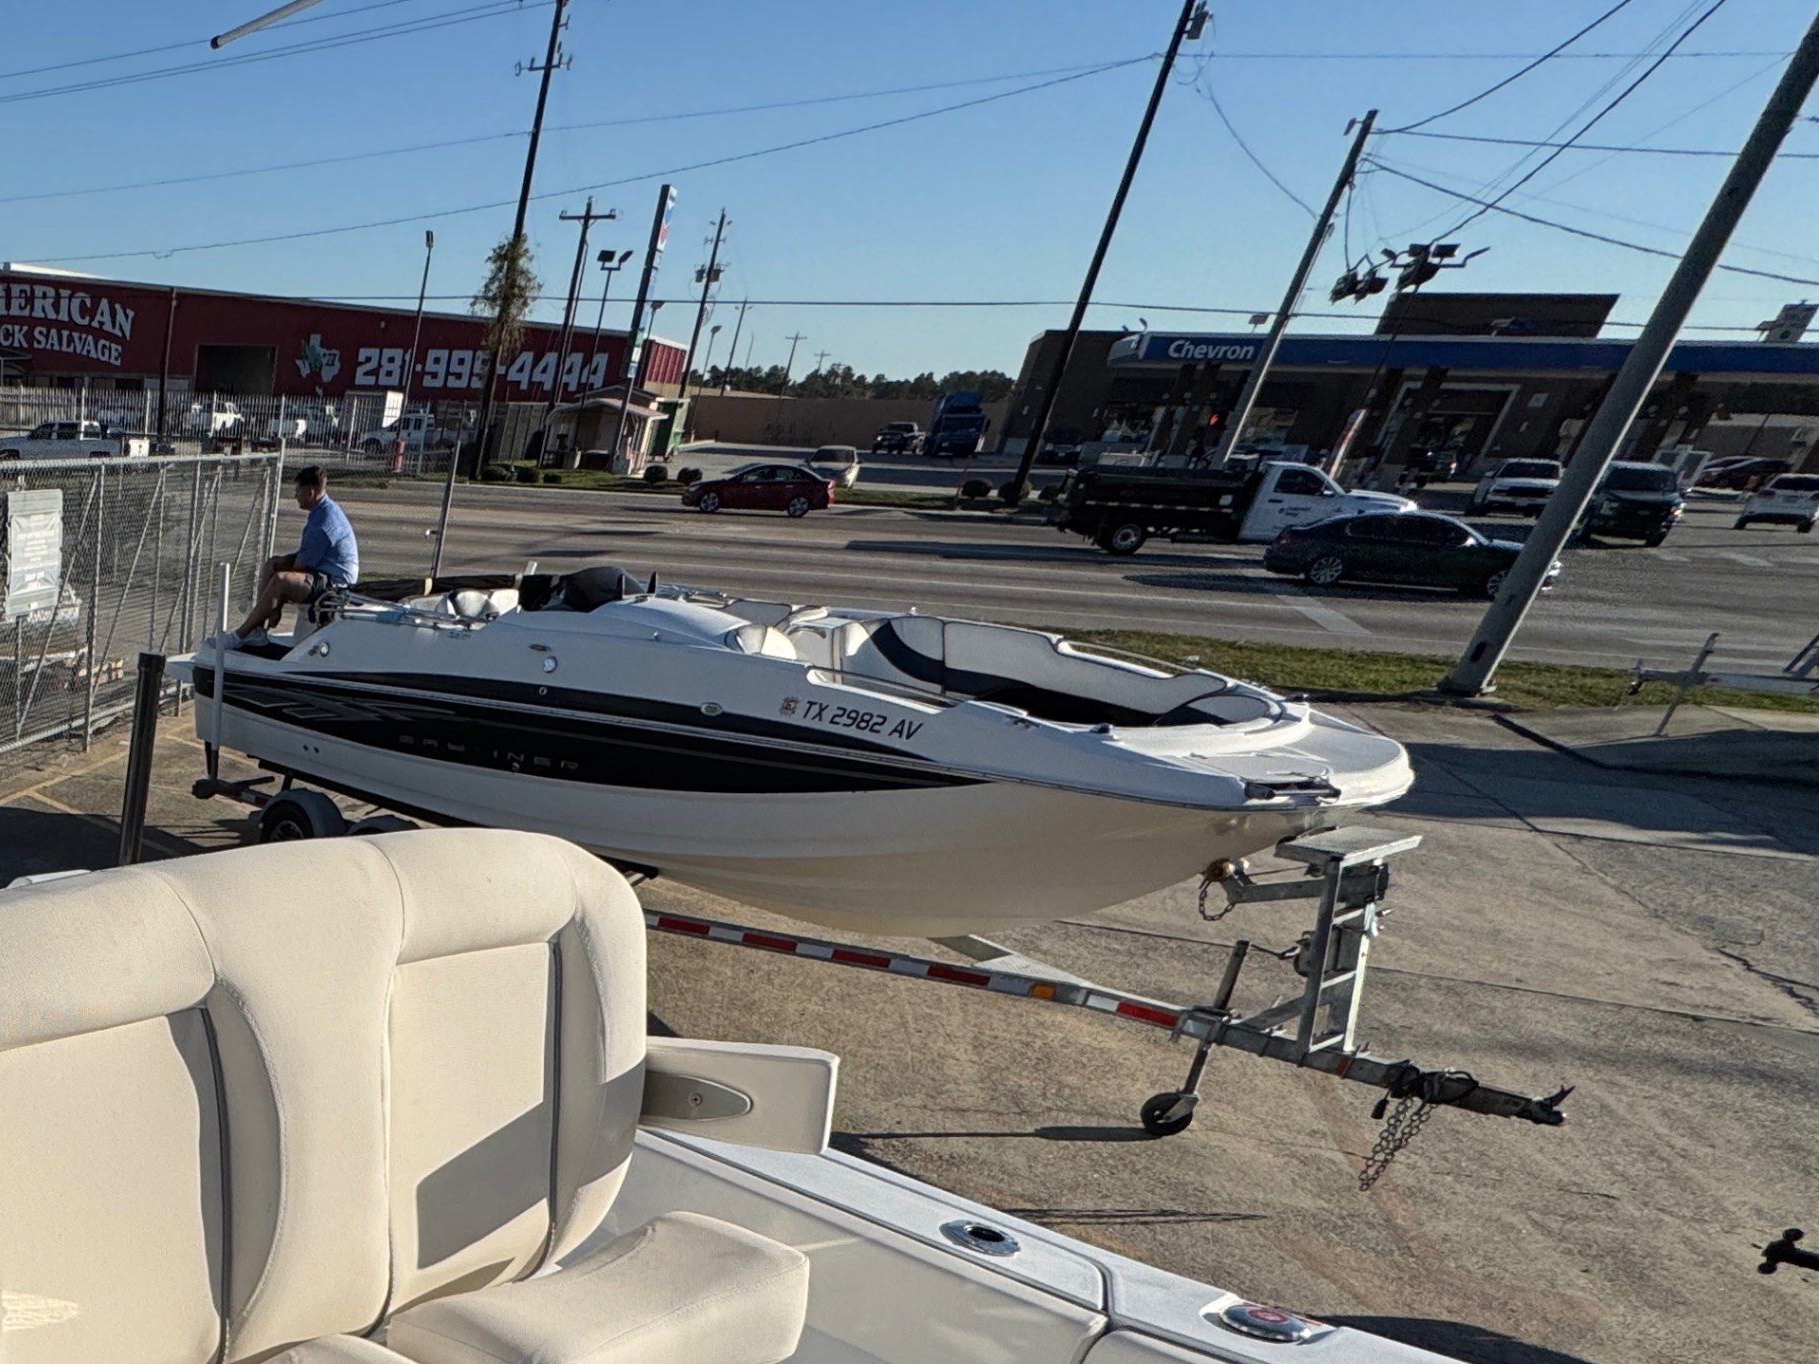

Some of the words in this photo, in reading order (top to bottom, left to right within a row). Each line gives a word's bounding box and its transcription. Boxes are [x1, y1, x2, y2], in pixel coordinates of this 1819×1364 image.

[33, 326, 122, 367] SALVAGE
[1167, 339, 1255, 360] Chevron
[802, 700, 830, 722] TX
[829, 706, 888, 734] 2982
[888, 719, 925, 740] AV
